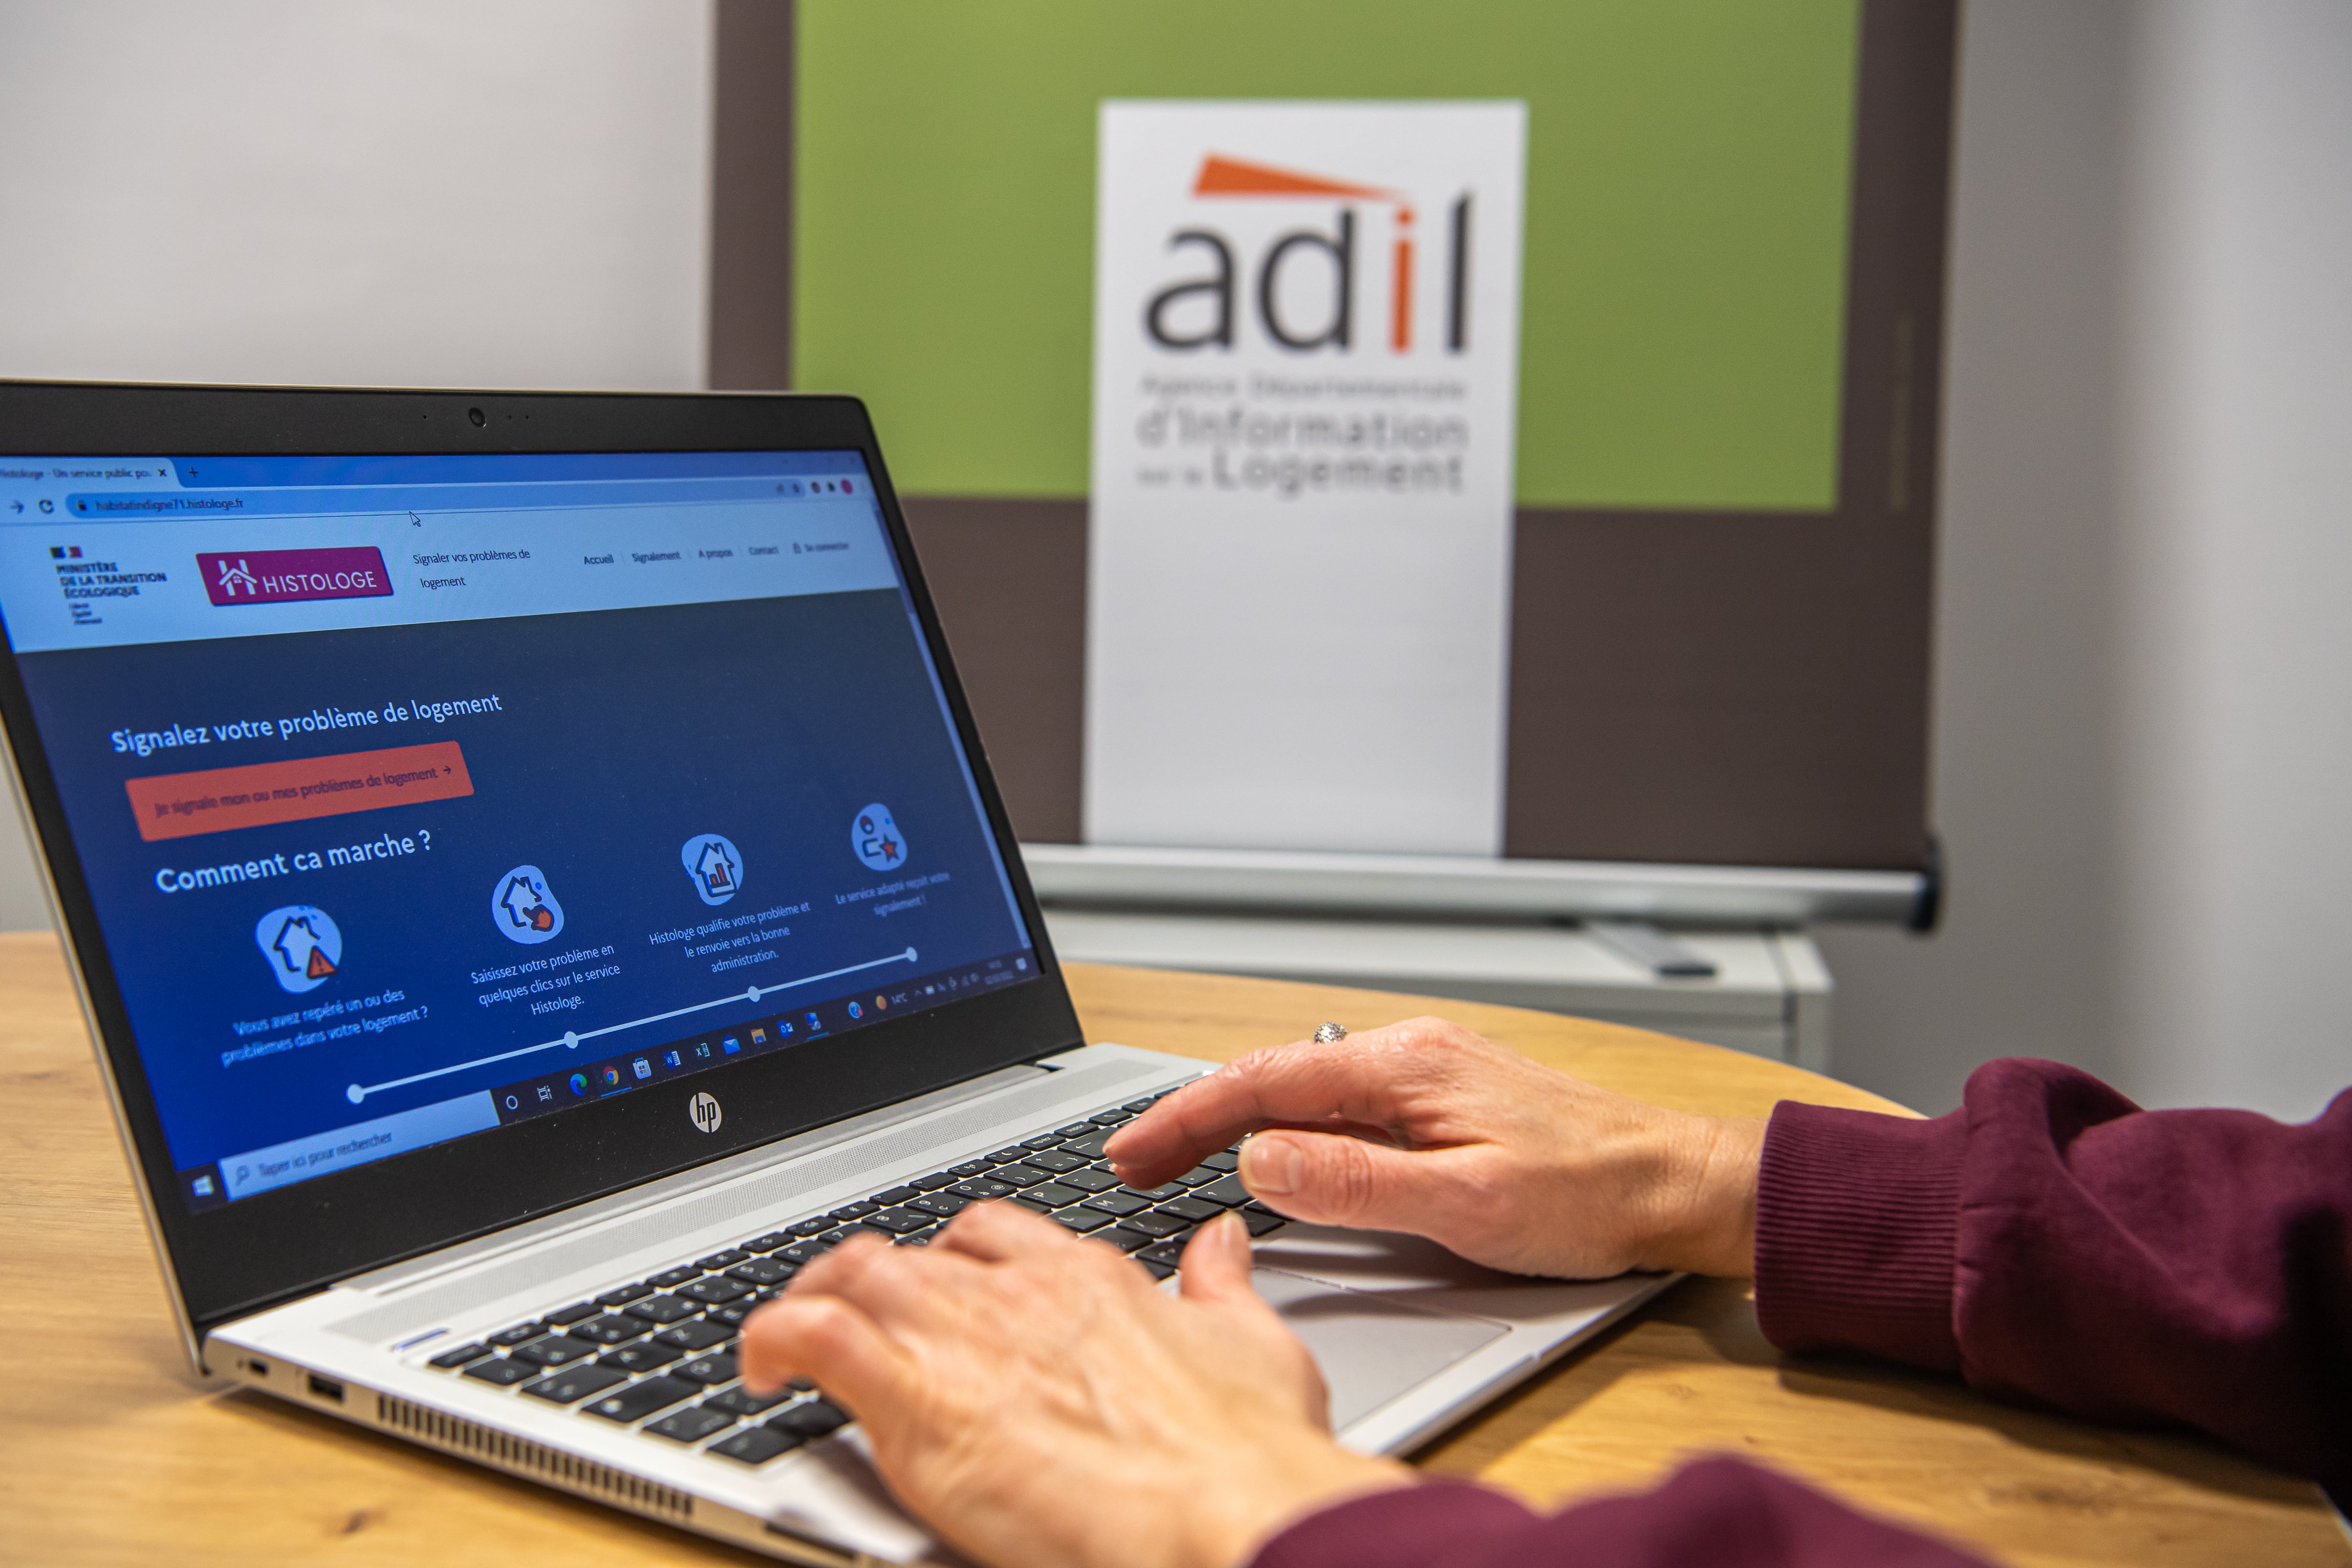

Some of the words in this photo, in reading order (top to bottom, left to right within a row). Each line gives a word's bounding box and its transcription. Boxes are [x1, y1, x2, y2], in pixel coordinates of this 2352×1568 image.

[1141, 189, 1474, 354] adil
[1135, 409, 1469, 448] d'Information
[1213, 445, 1465, 500] Logement
[96, 497, 243, 511] habitatindigne71.histologe.fr
[413, 552, 450, 566] Signaler
[451, 554, 468, 562] vos
[469, 550, 518, 564] problèmes
[518, 549, 531, 559] de
[584, 554, 614, 565] Accueil
[632, 550, 682, 564] Signalement
[698, 549, 705, 558] A
[706, 549, 733, 561] propos
[749, 546, 779, 555] Contact
[58, 576, 77, 586] DE
[78, 575, 96, 586] LA
[96, 572, 167, 585] TRANSITION
[261, 571, 378, 593] HISTOLOGE
[420, 576, 467, 589] logement
[109, 724, 210, 757] Signalez
[212, 719, 274, 741] votre
[276, 708, 379, 740] problème
[383, 702, 409, 722] de
[411, 694, 502, 723] logement
[154, 803, 169, 818] Je
[173, 794, 218, 816] signale
[220, 792, 251, 806] mon
[252, 791, 270, 803] ou
[272, 787, 298, 800] mes
[301, 777, 364, 800] problèmes
[366, 774, 381, 787] de
[383, 768, 438, 788] logement
[154, 854, 289, 893] Comment
[292, 850, 323, 871] ca
[327, 833, 415, 866] marche
[418, 829, 431, 850] ?
[835, 893, 847, 905] Le
[847, 889, 876, 903] service
[875, 882, 904, 897] adapté
[873, 896, 922, 917] signalement
[649, 928, 695, 945] Histologe
[696, 918, 731, 937] qualifie
[731, 915, 756, 928] votre
[757, 904, 800, 924] problème
[800, 902, 811, 912] et
[684, 947, 695, 958] le
[696, 938, 731, 956] renvoie
[731, 935, 751, 947] vers
[752, 932, 761, 944] la
[761, 926, 791, 942] bonne
[470, 966, 518, 985] Saisissez
[518, 959, 548, 974] votre
[549, 949, 599, 970] problème
[601, 945, 615, 957] en
[711, 949, 779, 973] administration.
[479, 985, 529, 1008] quelques
[530, 978, 554, 994] clics
[555, 976, 571, 988] sur
[573, 971, 584, 985] le
[585, 964, 621, 981] service
[232, 1019, 270, 1036] Vous
[270, 1013, 301, 1028] avez
[303, 1002, 344, 1022] repéré
[345, 999, 363, 1013] un
[364, 996, 381, 1007] ou
[382, 989, 405, 1003] des
[531, 995, 585, 1016] Histologe.
[220, 1037, 294, 1068] problèmes
[294, 1030, 326, 1047] dans
[327, 1024, 361, 1039] votre
[362, 1010, 419, 1034] logement
[420, 1005, 428, 1018] ?
[695, 1092, 717, 1132] hp
